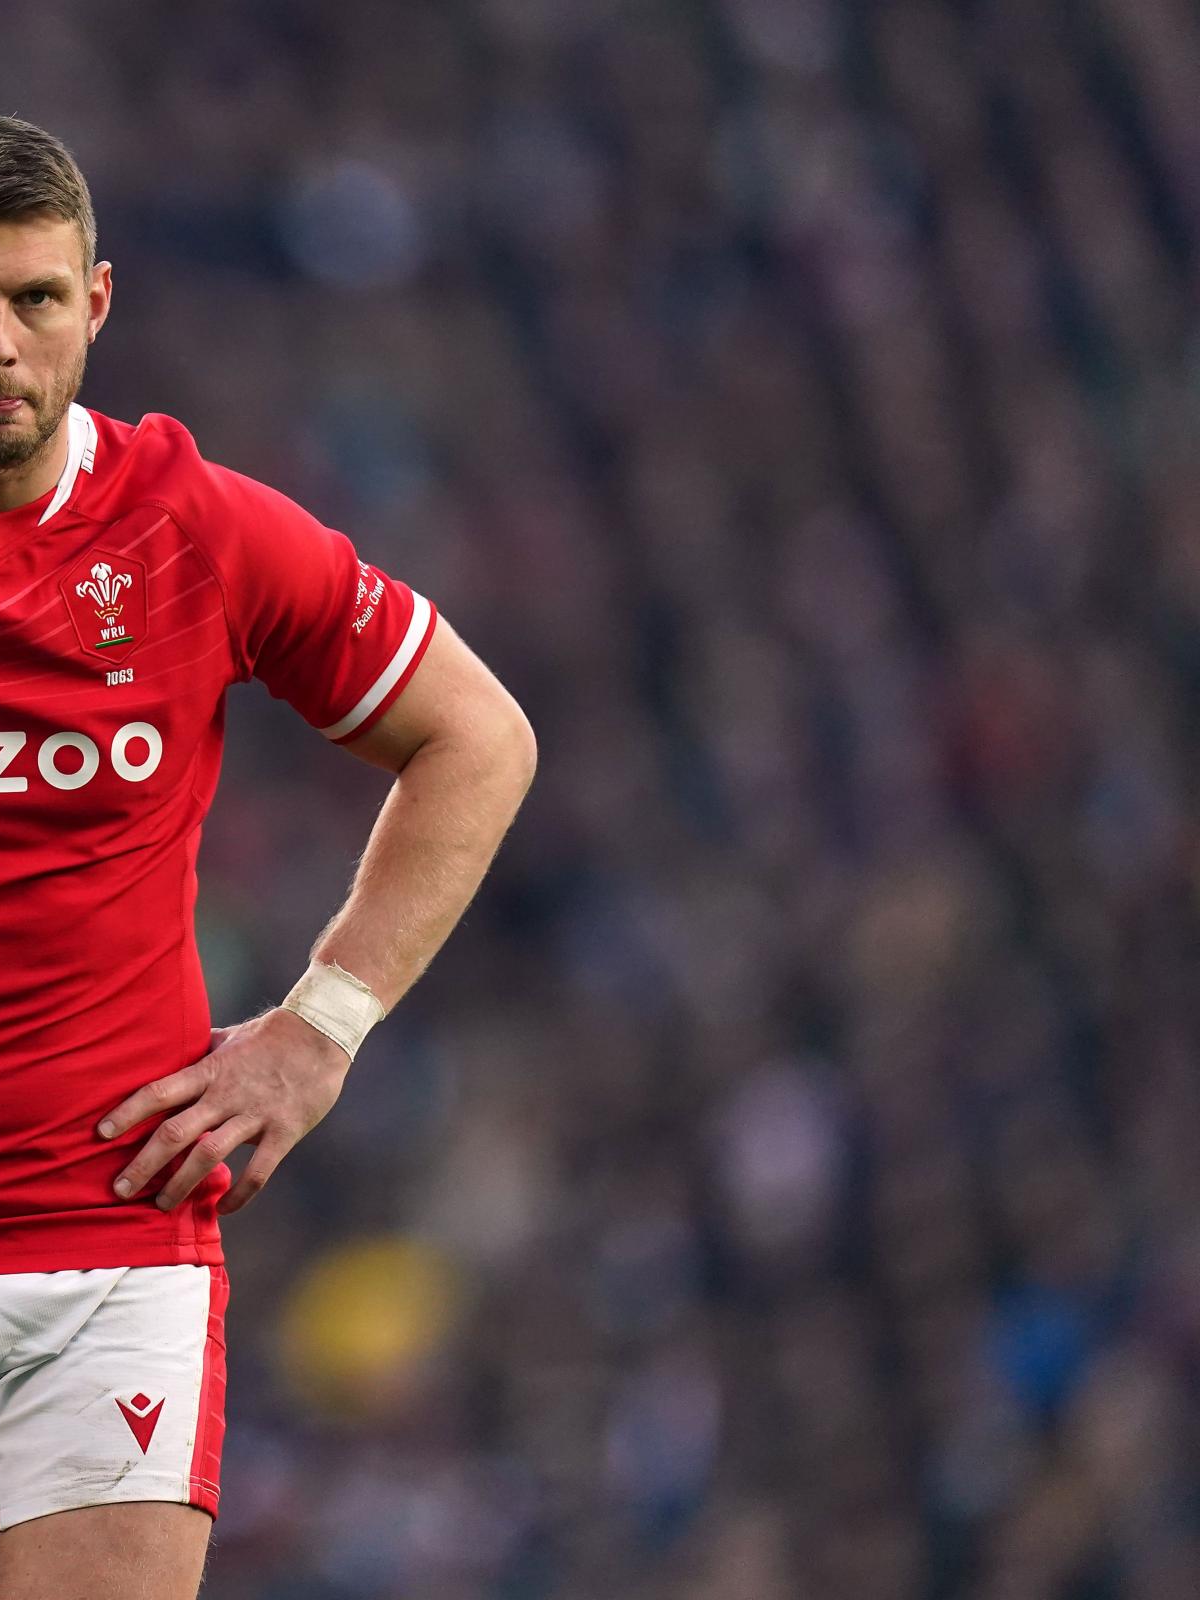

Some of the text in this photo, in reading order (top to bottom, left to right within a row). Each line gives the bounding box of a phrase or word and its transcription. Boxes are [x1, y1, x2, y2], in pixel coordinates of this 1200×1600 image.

[352, 605, 375, 634] 26ain
[100, 625, 126, 641] WRU
[105, 668, 134, 686] 1063
